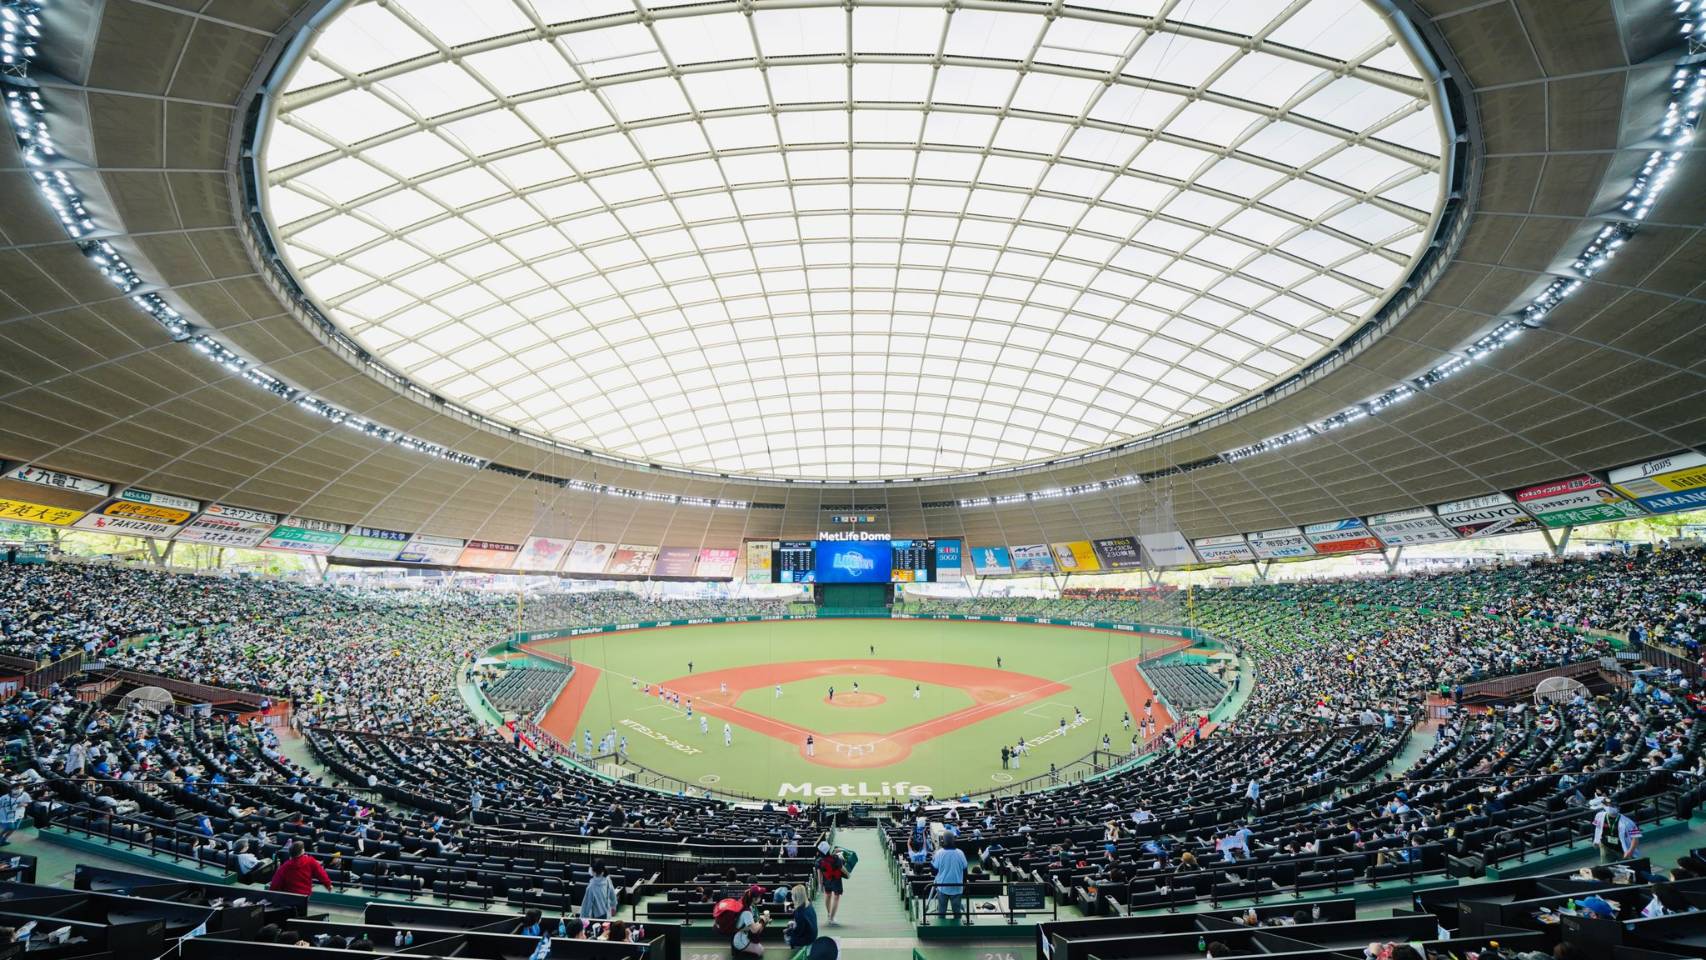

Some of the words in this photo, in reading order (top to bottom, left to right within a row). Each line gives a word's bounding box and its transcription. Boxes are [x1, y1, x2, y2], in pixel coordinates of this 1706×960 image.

[1641, 458, 1672, 476] Lions
[36, 470, 81, 490] 九電工
[1446, 507, 1521, 525] KOKUYO
[108, 518, 168, 532] TAKIZAWA
[820, 531, 860, 541] MetLife
[861, 532, 892, 541] Dome
[778, 781, 934, 797] MetLife
